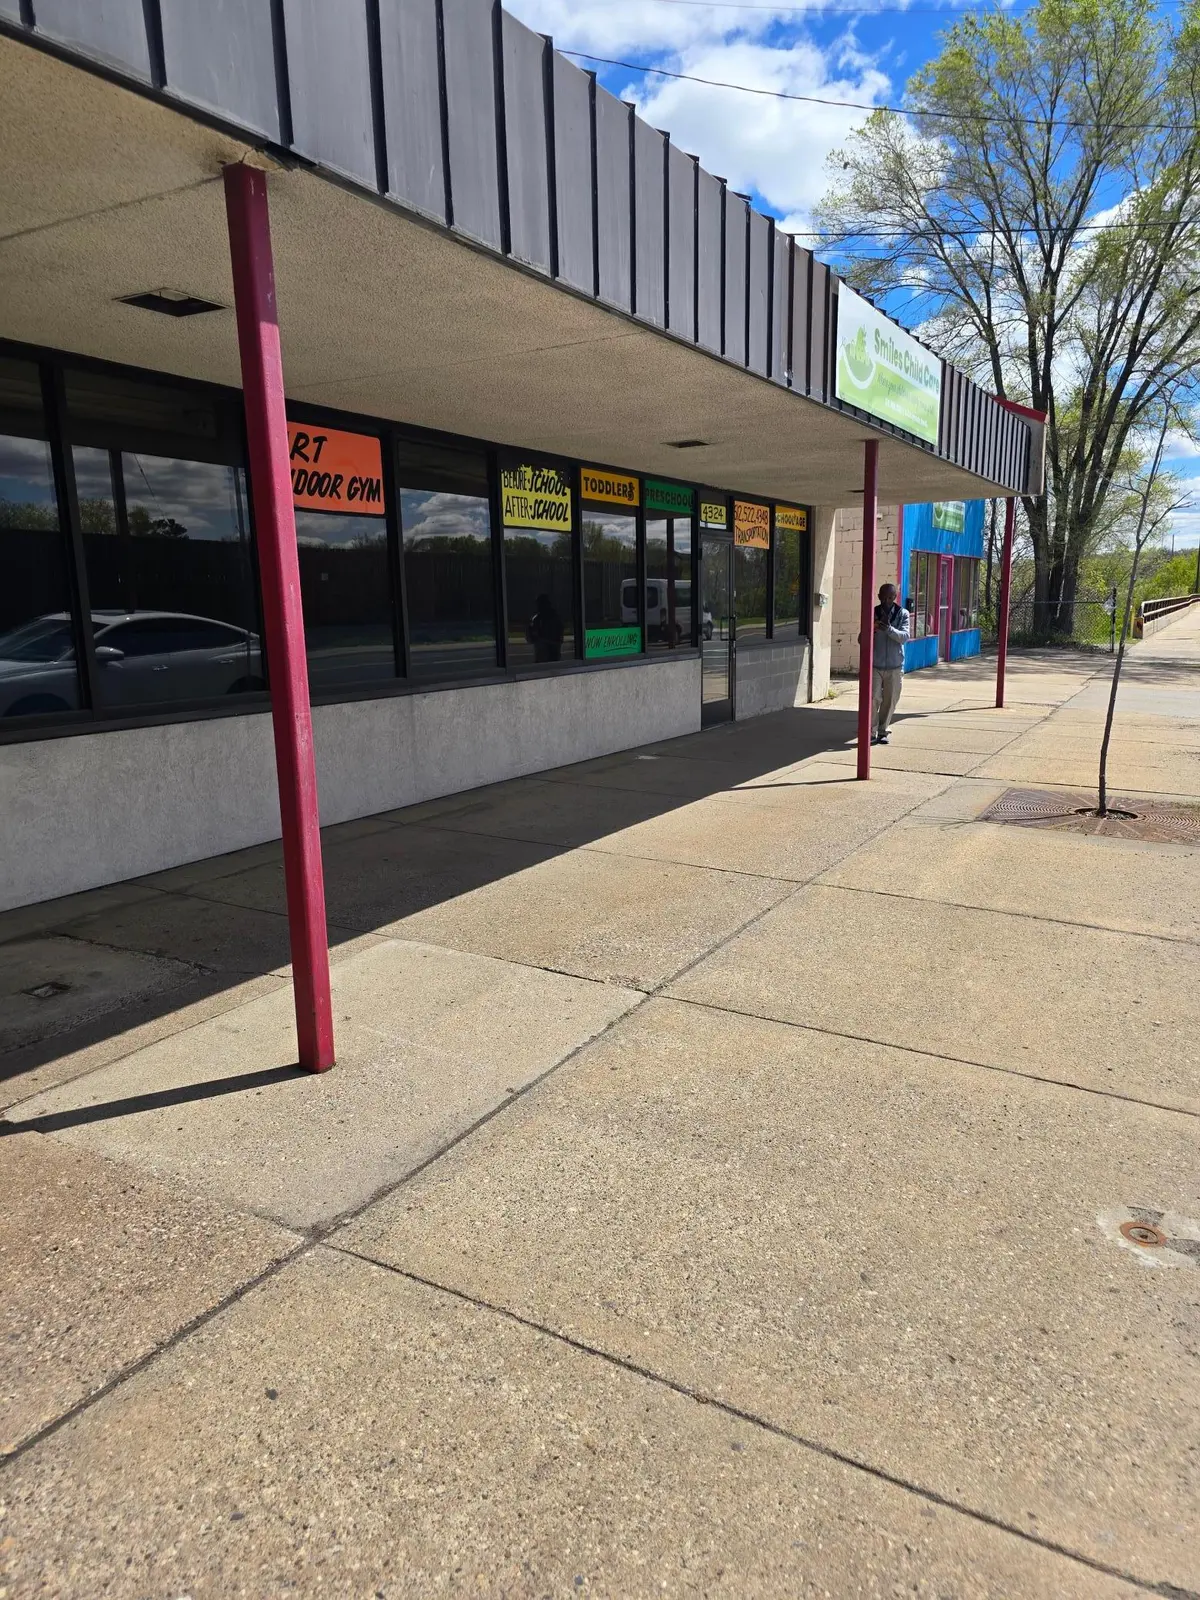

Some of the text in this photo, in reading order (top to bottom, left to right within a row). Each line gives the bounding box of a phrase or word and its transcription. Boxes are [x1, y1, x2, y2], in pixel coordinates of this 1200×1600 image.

[874, 328, 903, 371] Smiles
[904, 349, 923, 385] Child
[923, 364, 940, 395] Care
[287, 431, 328, 464] RT
[291, 468, 381, 503] DOOR GYM
[702, 505, 723, 521] 4324
